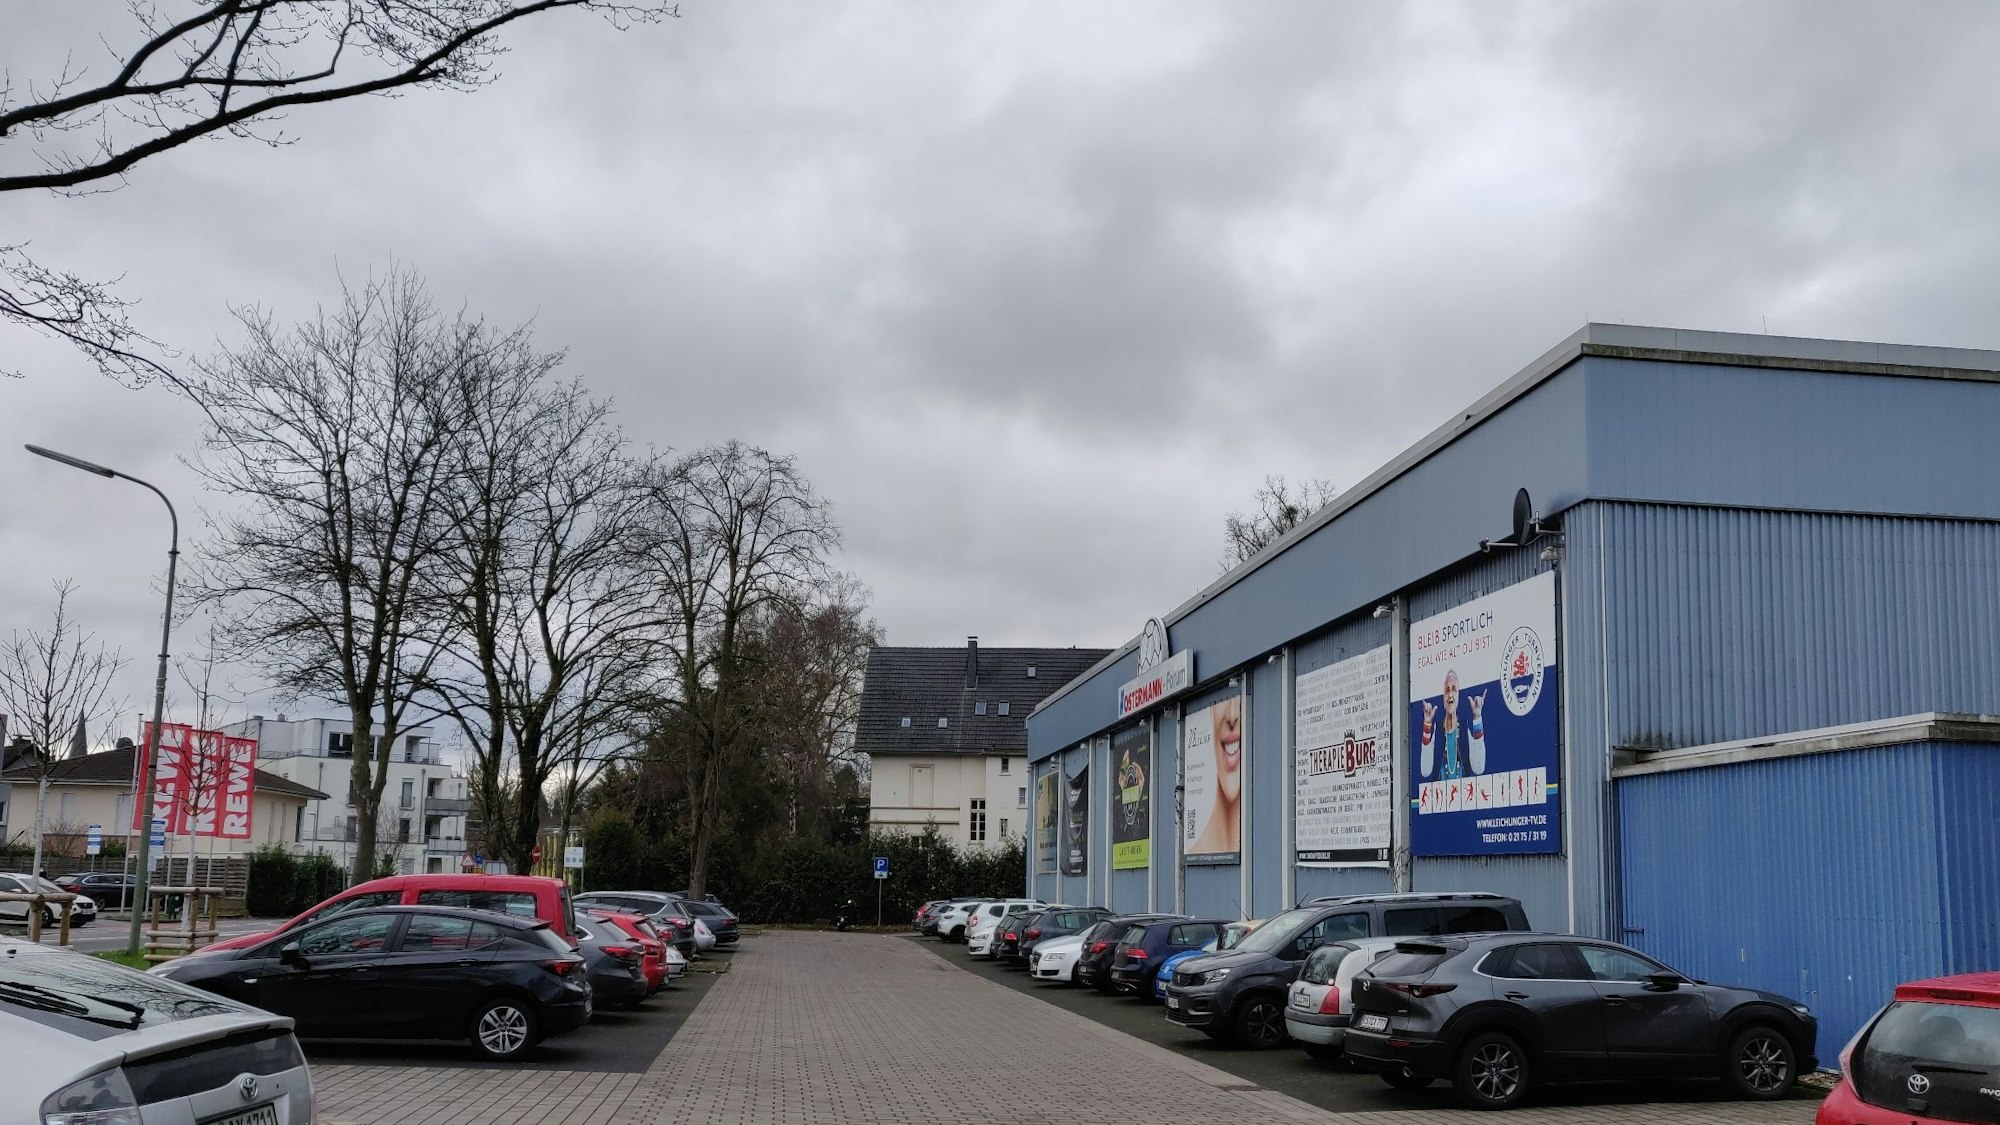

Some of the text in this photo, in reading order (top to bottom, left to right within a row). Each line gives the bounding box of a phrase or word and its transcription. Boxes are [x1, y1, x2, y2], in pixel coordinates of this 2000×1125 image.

[1418, 609, 1493, 650] BLEIB SPORTLICH
[1418, 633, 1493, 669] EGAL WIE ALT DU BIST!
[1503, 635, 1519, 704] LEICHLINGER
[1524, 633, 1541, 699] TURNVEREIN
[1124, 677, 1163, 713] OSTERMANN
[185, 735, 217, 832] REWE
[223, 743, 252, 835] REWE
[1476, 814, 1547, 829] WWW.LEICHLINGER-TV.DE
[1482, 832, 1507, 843] TELEFON:
[1508, 831, 1512, 842] 0
[1513, 831, 1520, 842] 21
[1520, 831, 1527, 841] 75
[1532, 830, 1539, 841] 31
[1540, 830, 1547, 841] 19
[877, 859, 885, 870] P
